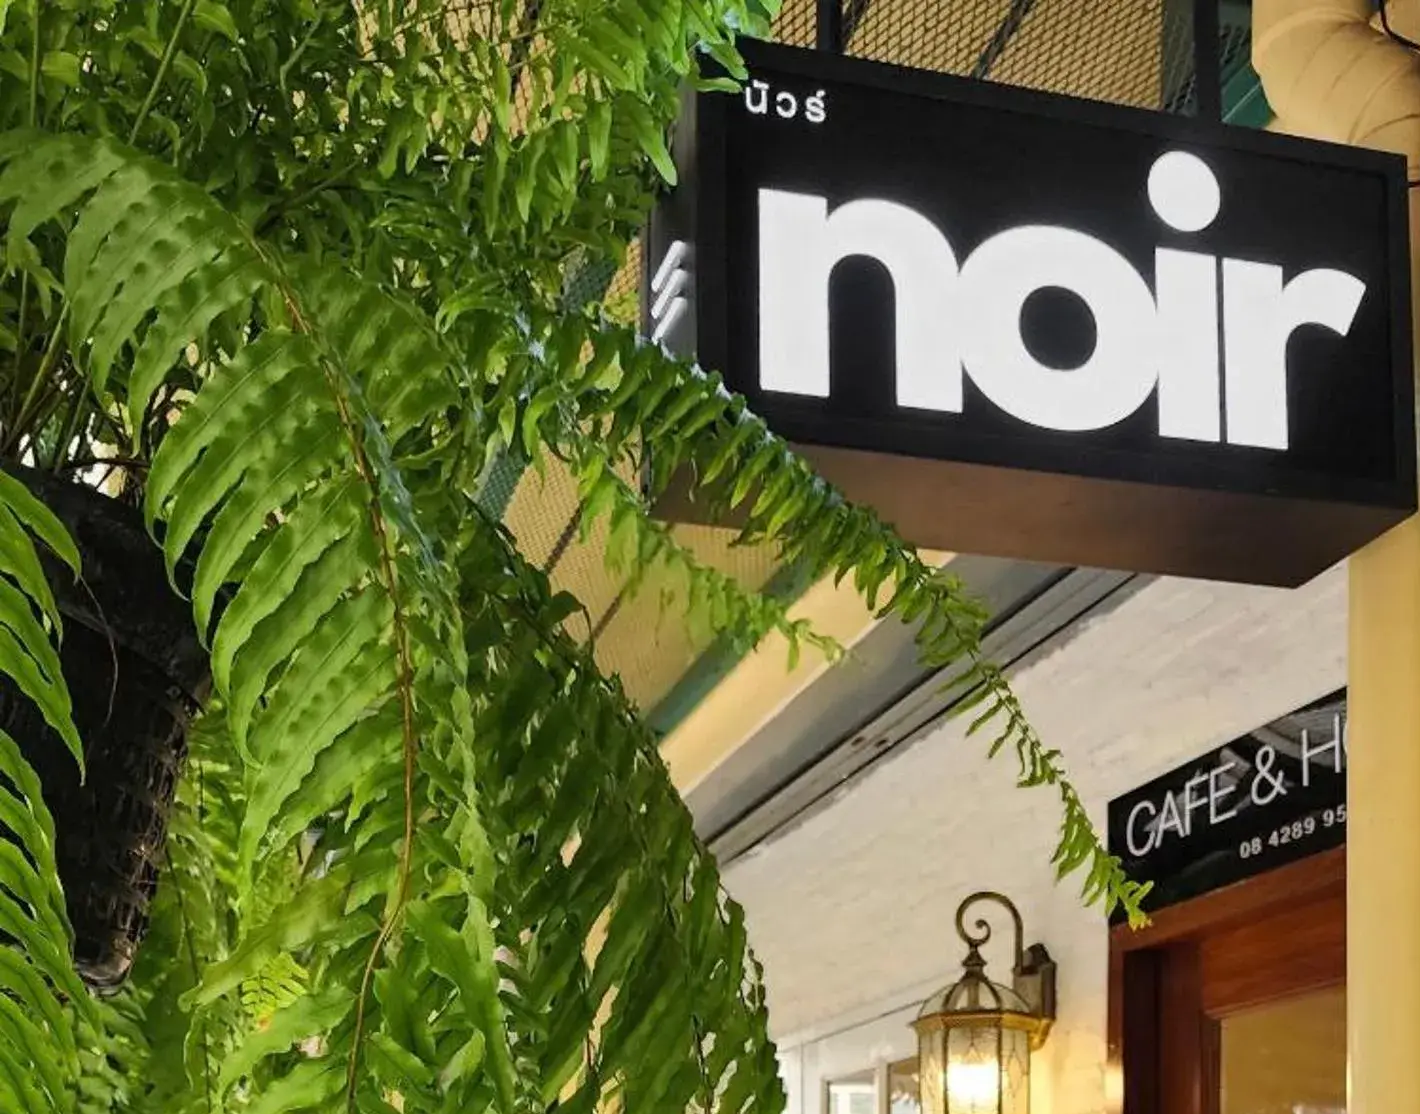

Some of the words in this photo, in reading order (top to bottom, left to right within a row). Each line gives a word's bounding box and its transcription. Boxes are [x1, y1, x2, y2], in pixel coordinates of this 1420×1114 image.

[757, 150, 1367, 451] noir
[1126, 761, 1238, 857] CAFE
[1251, 745, 1288, 806] &
[1302, 712, 1347, 787] H
[1239, 836, 1262, 858] 08
[1267, 816, 1316, 847] 4289
